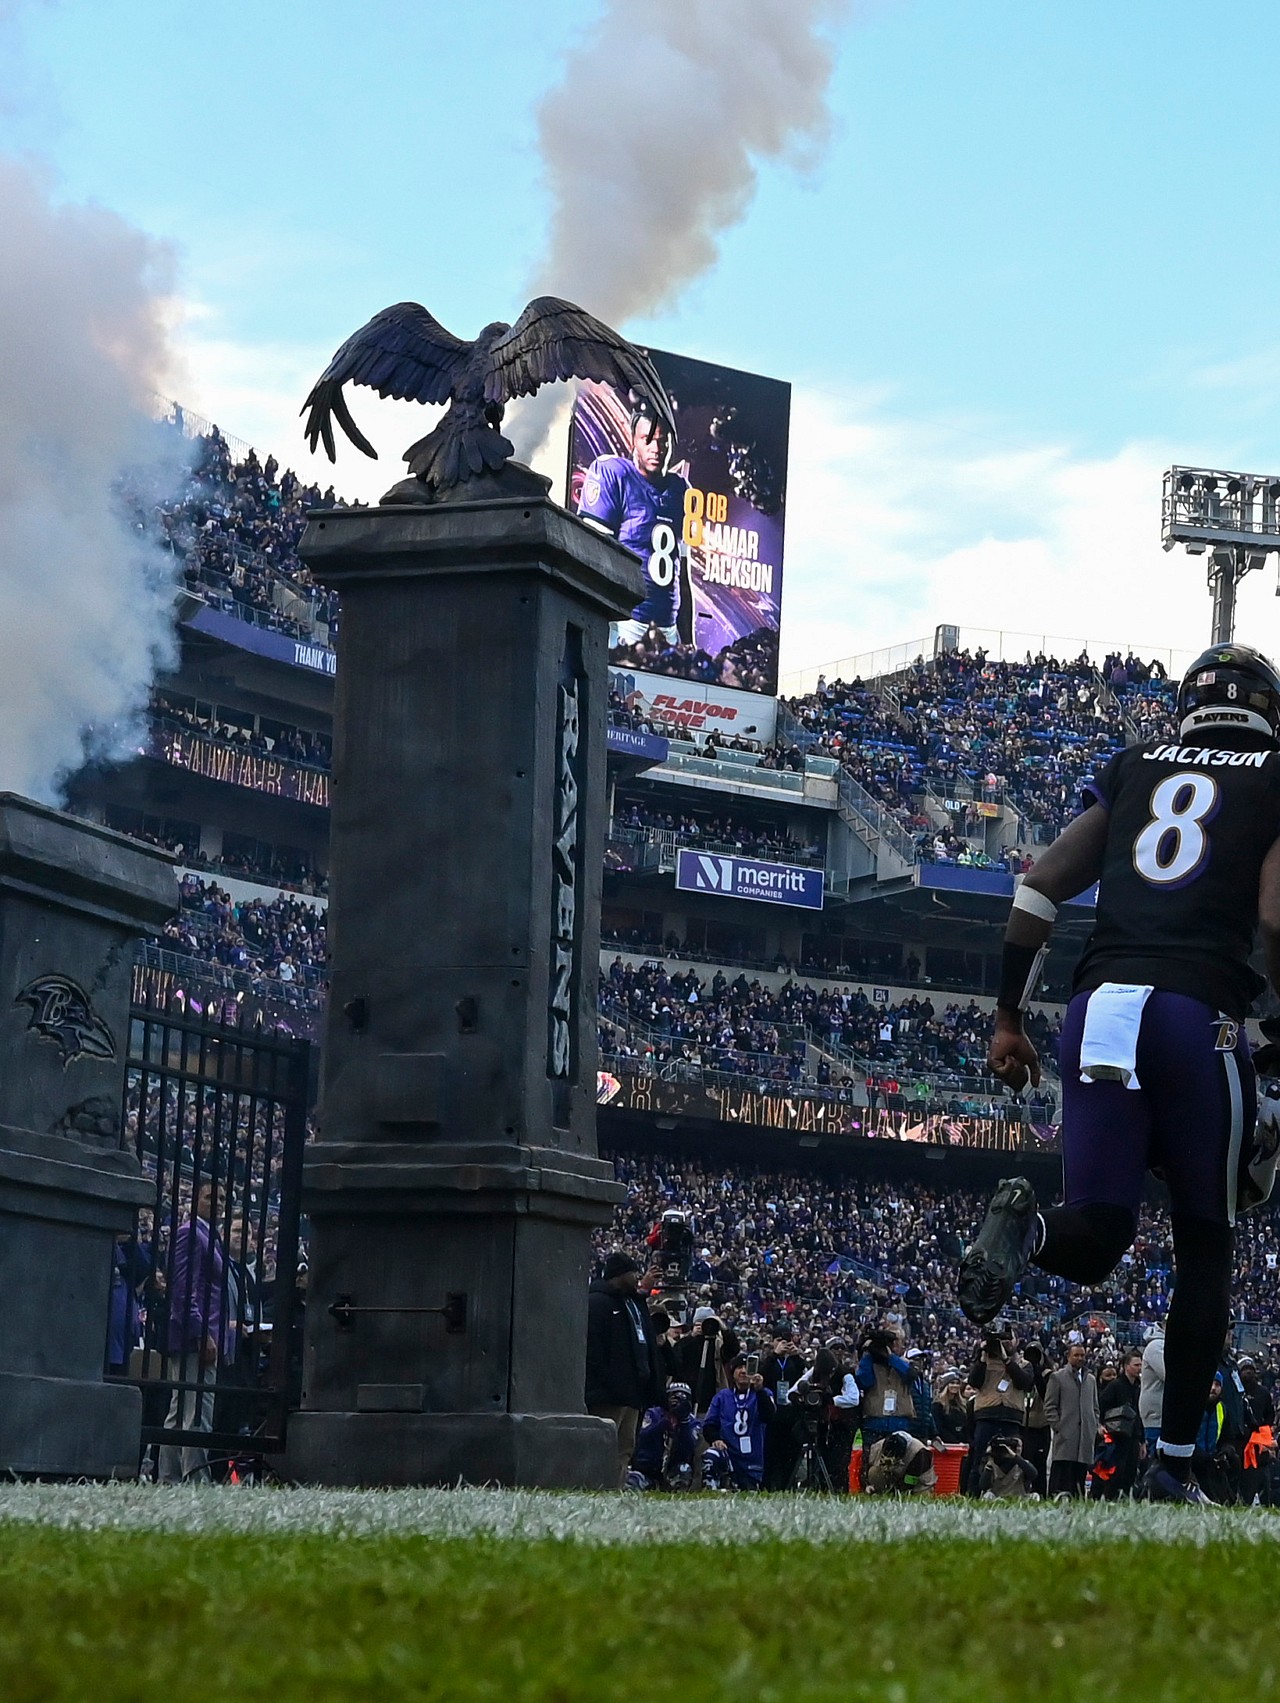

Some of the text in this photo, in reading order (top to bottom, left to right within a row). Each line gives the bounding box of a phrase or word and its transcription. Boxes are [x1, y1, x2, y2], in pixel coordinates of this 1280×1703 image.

[683, 488, 727, 547] 8 QB
[704, 521, 759, 560] LAMAR
[648, 524, 675, 587] 8
[703, 552, 773, 593] JACKSON
[295, 643, 323, 670] THANK
[1227, 683, 1237, 699] 8
[649, 708, 707, 727] ZONE
[652, 694, 738, 721] FLAVOR
[1193, 713, 1250, 725] RAVENS
[1143, 745, 1271, 768] JACKSON
[1133, 771, 1220, 887] 8
[737, 886, 783, 899] COMPANIES
[738, 869, 805, 892] merritt
[734, 1410, 748, 1435] 8
